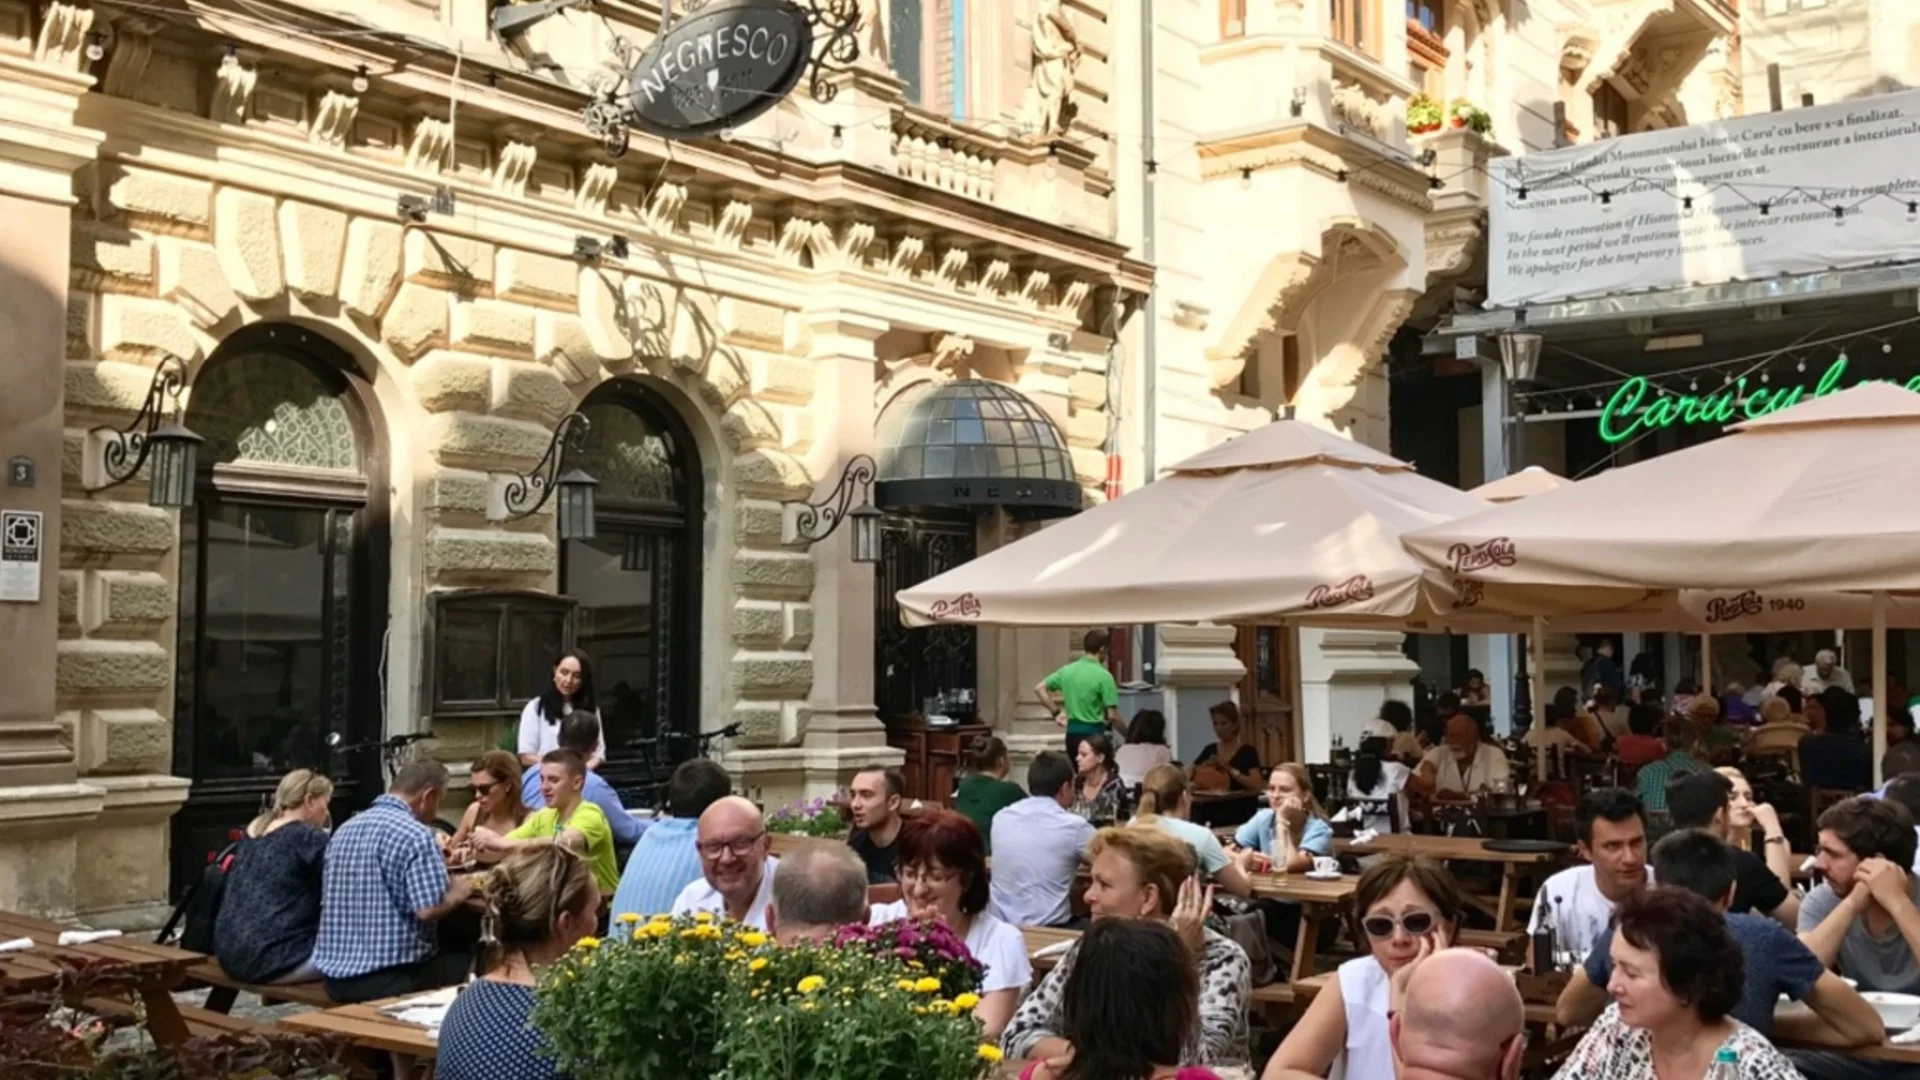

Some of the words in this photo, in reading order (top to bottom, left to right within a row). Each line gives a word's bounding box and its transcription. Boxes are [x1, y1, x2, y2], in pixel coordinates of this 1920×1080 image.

[641, 23, 788, 103] NEGRESCO
[1609, 138, 1698, 161] Monumentului
[1778, 126, 1793, 137] cu
[1795, 120, 1822, 134] bere
[1846, 107, 1904, 126] finalizat.
[1760, 143, 1776, 157] de
[1778, 137, 1841, 155] restaurare
[1843, 135, 1852, 144] a
[1507, 231, 1524, 244] The
[1565, 220, 1622, 238] restoration
[1507, 249, 1519, 261] In
[1522, 245, 1539, 258] the
[1541, 246, 1566, 257] next
[1567, 239, 1601, 258] period
[1632, 229, 1679, 245] continue
[1507, 264, 1523, 276] We
[1525, 260, 1577, 279] apologize
[1577, 255, 1595, 273] for
[1596, 252, 1614, 267] the
[1616, 245, 1674, 265] temporary
[15, 465, 27, 481] 3
[1769, 598, 1805, 611] 1940
